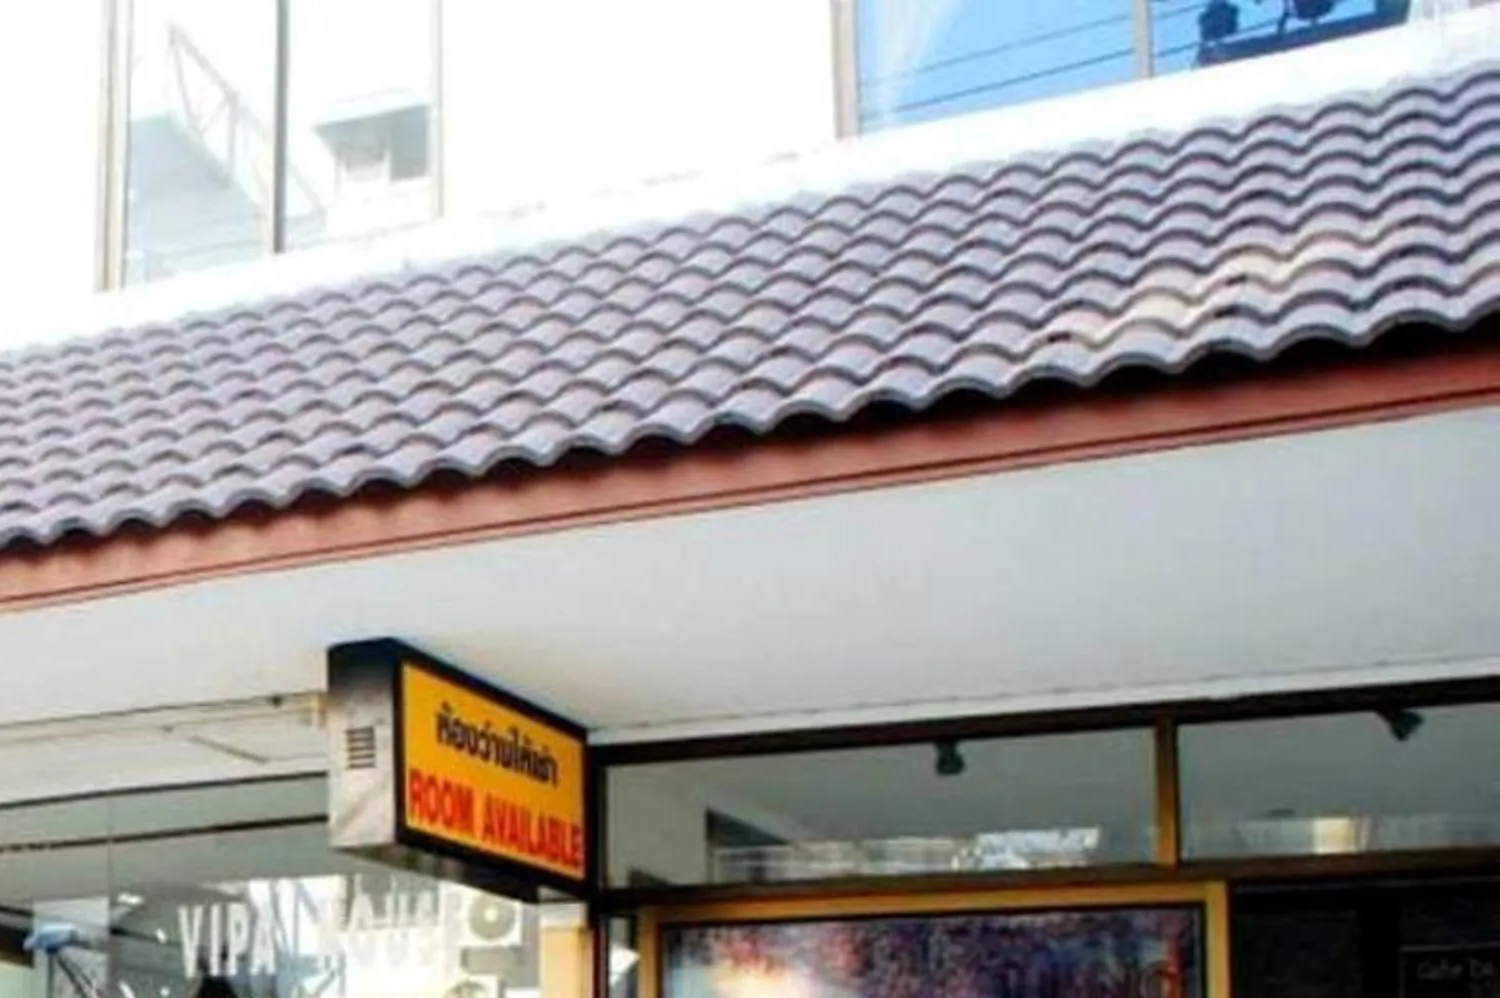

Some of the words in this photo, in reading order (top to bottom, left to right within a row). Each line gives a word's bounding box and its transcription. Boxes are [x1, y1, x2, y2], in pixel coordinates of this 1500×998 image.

[409, 767, 475, 831] ROOM
[482, 793, 584, 868] AVAILABLE
[178, 900, 277, 978] VIPA
